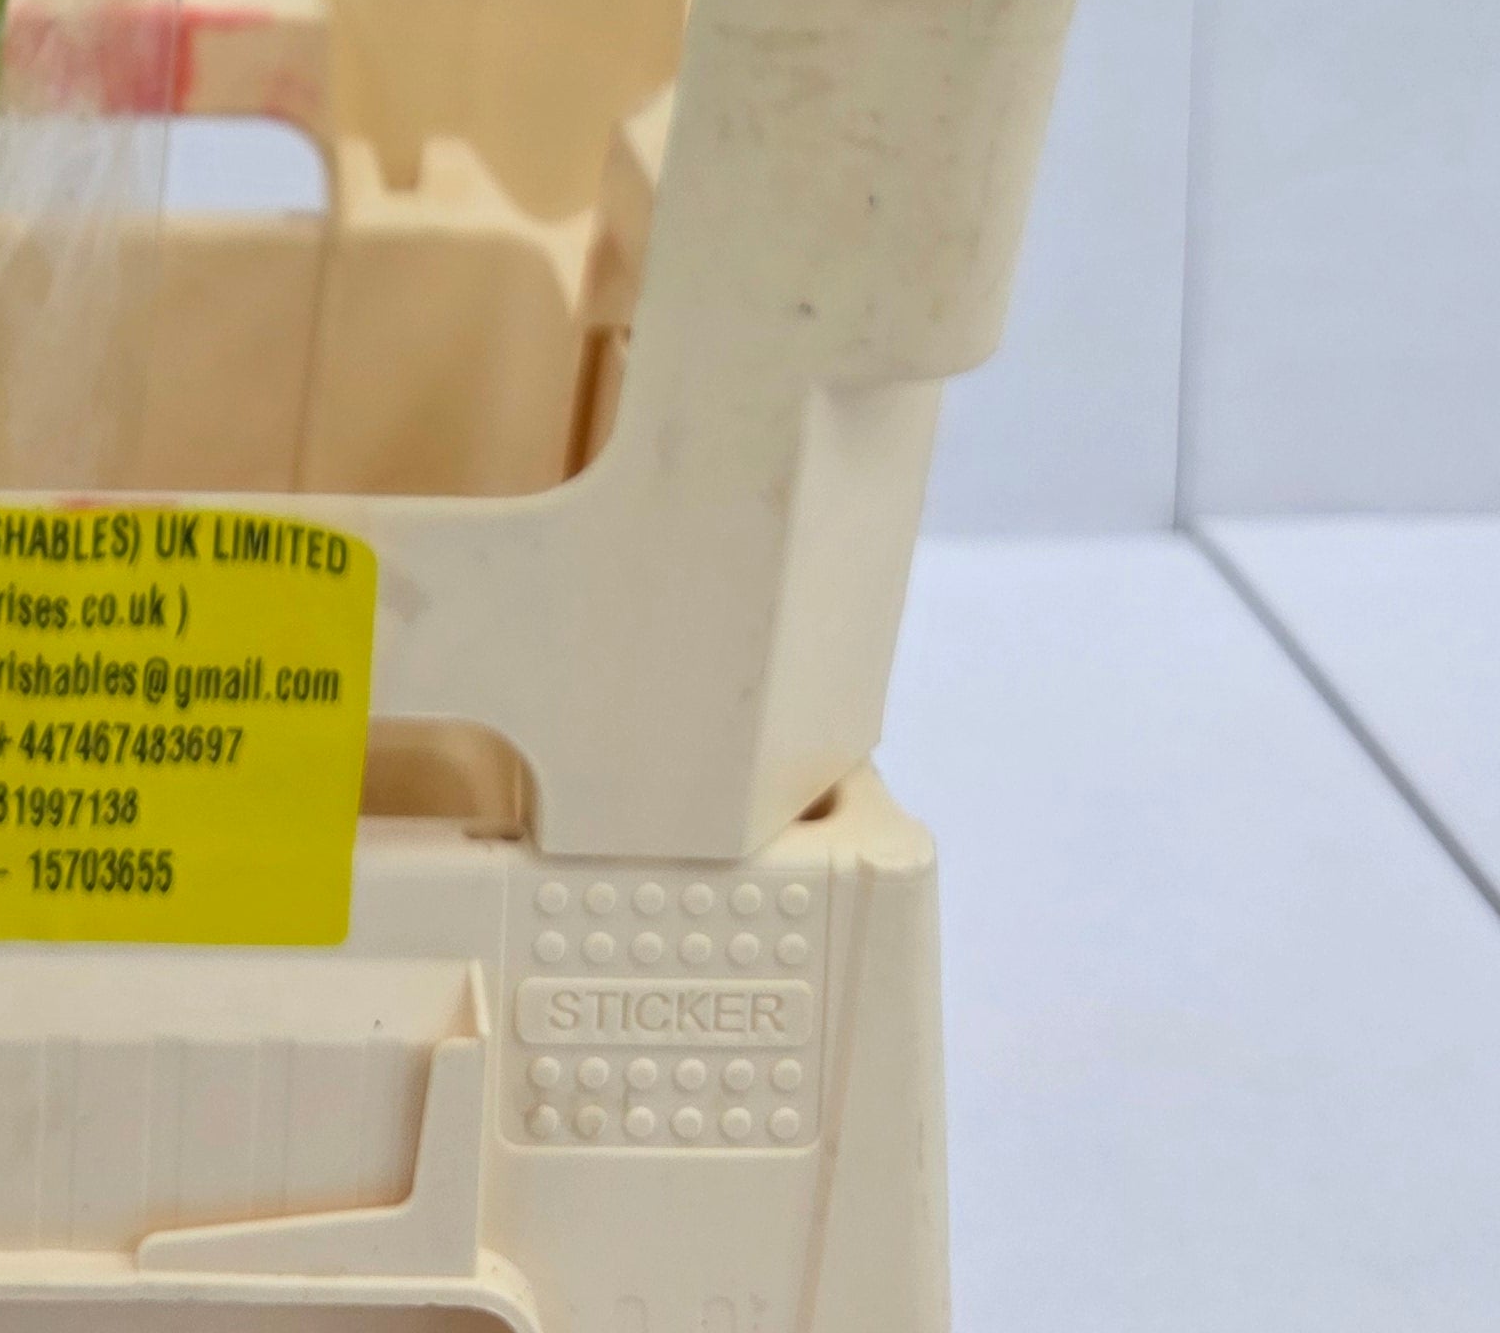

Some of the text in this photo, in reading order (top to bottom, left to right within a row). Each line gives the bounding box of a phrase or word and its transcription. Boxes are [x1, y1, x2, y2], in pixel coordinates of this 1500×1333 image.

[156, 514, 199, 560] UK
[214, 516, 350, 576] LIMITED
[29, 850, 173, 895] 15703655
[548, 989, 786, 1033] STICKER
